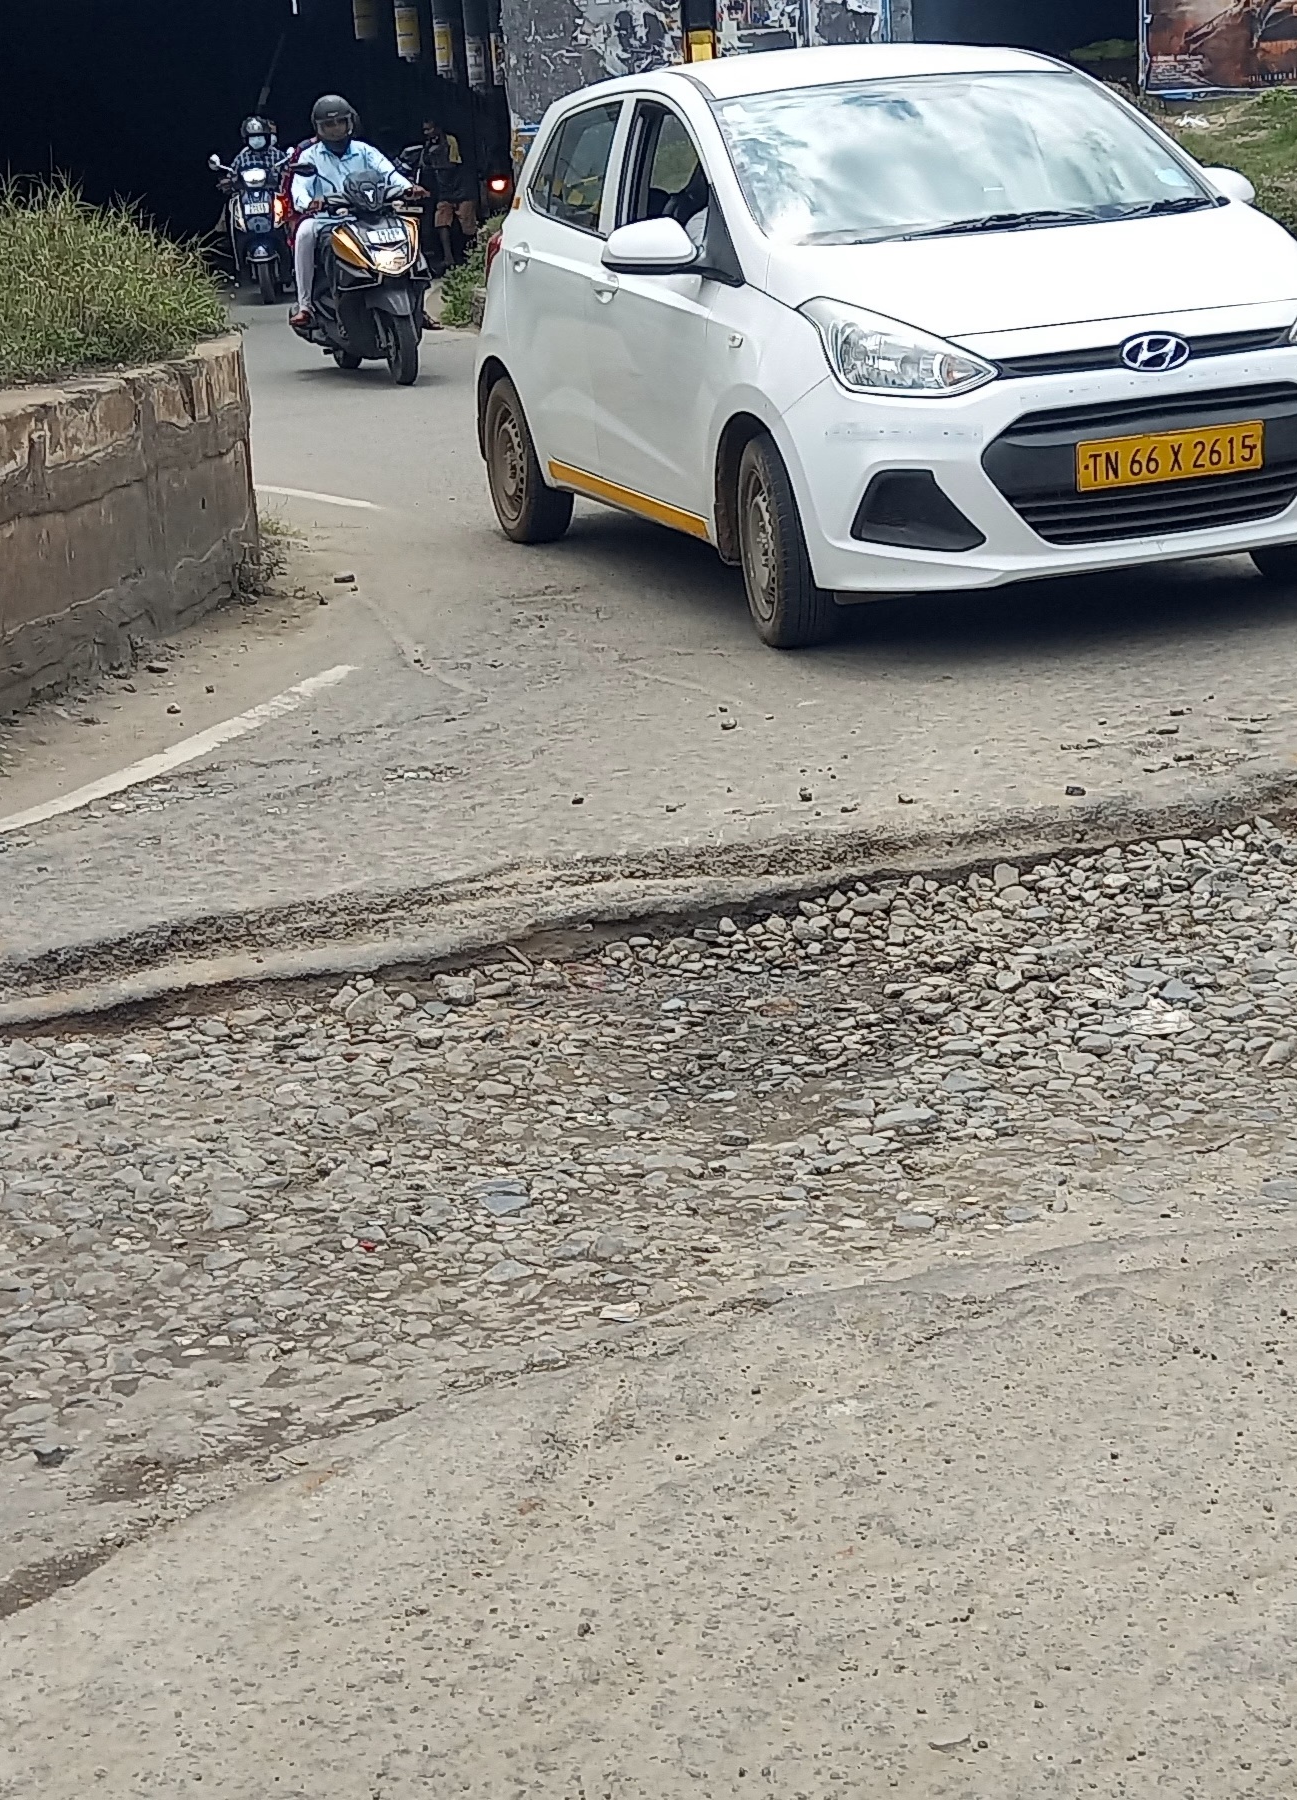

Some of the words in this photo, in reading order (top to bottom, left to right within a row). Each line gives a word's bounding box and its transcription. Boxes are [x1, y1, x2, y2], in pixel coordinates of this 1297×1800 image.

[1088, 451, 1119, 482] TN
[1129, 445, 1160, 477] 66
[1170, 442, 1183, 473] X
[1192, 434, 1255, 469] 2615
